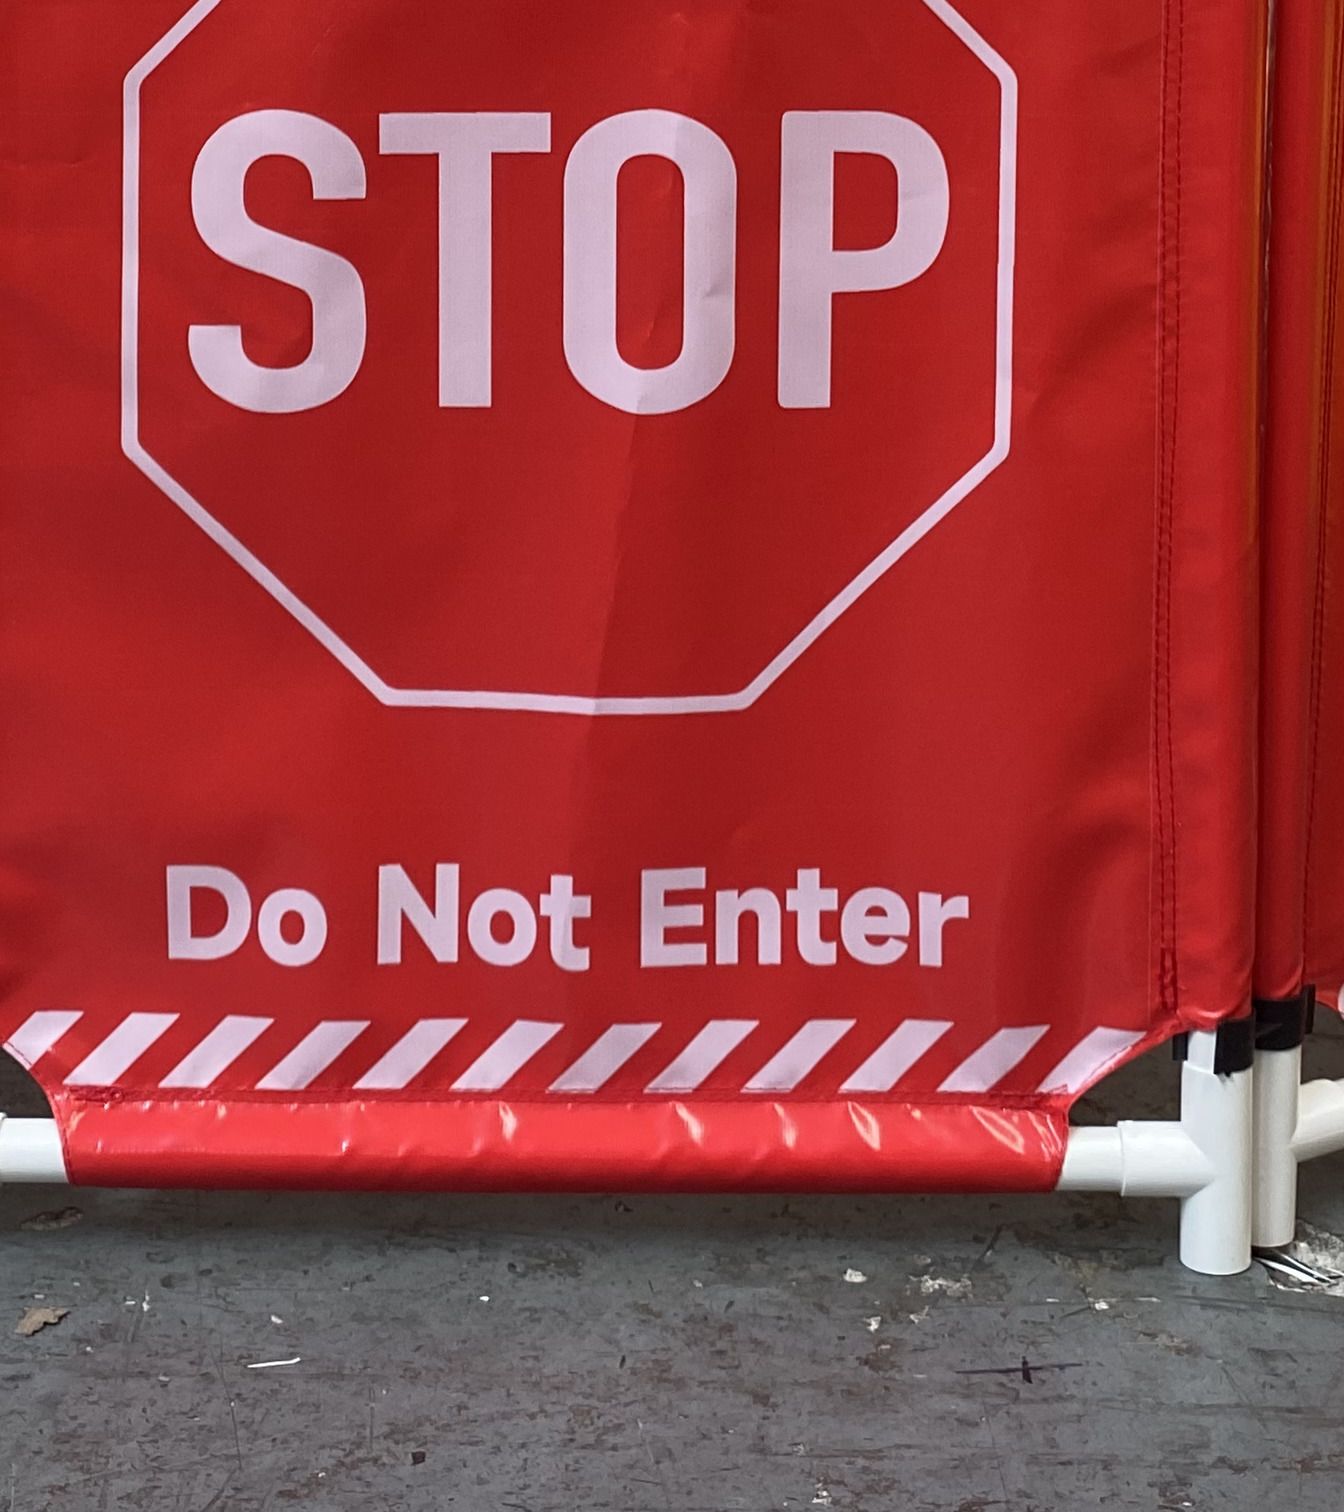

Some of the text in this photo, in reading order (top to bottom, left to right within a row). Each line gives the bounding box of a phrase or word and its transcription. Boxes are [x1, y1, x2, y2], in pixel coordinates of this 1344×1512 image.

[186, 108, 950, 415] STOP
[165, 862, 973, 971] Do Not Enter
